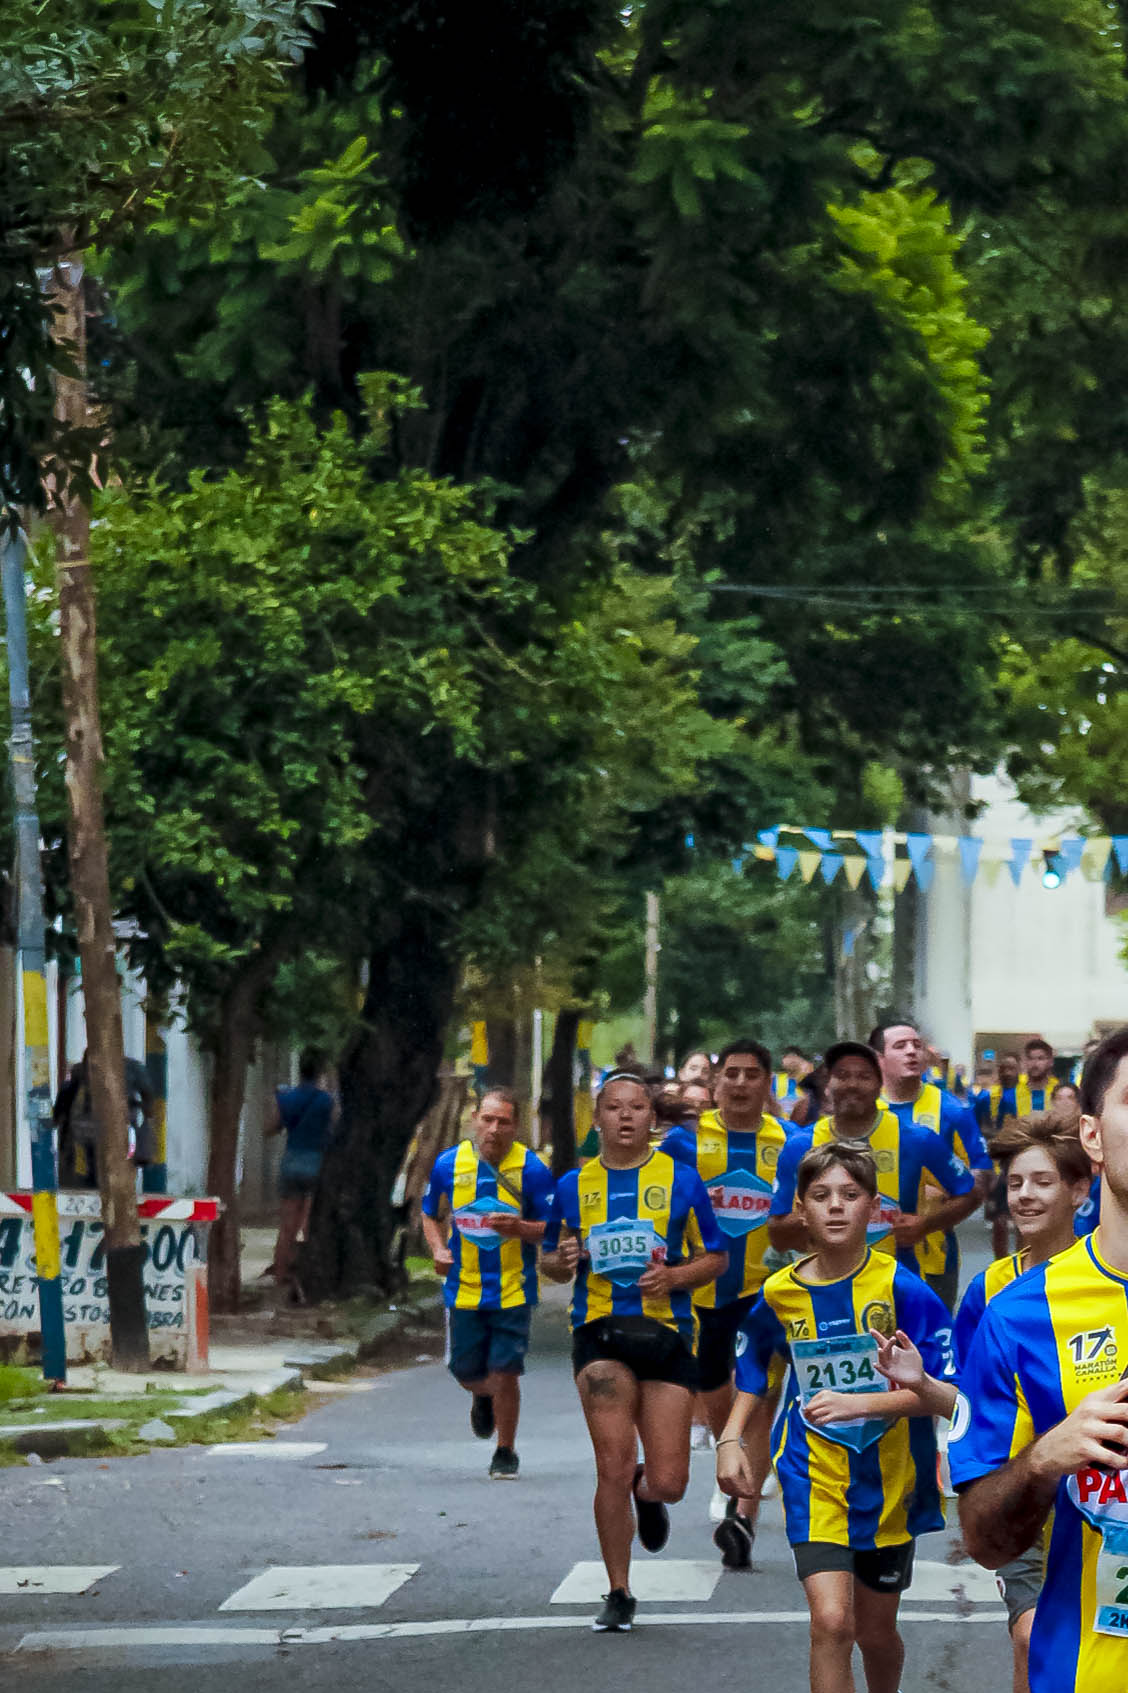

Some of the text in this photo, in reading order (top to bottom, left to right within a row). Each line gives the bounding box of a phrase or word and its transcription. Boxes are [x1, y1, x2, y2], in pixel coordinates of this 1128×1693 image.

[600, 1236, 647, 1257] 3035
[1069, 1328, 1112, 1362] 17
[807, 1357, 875, 1388] 2134
